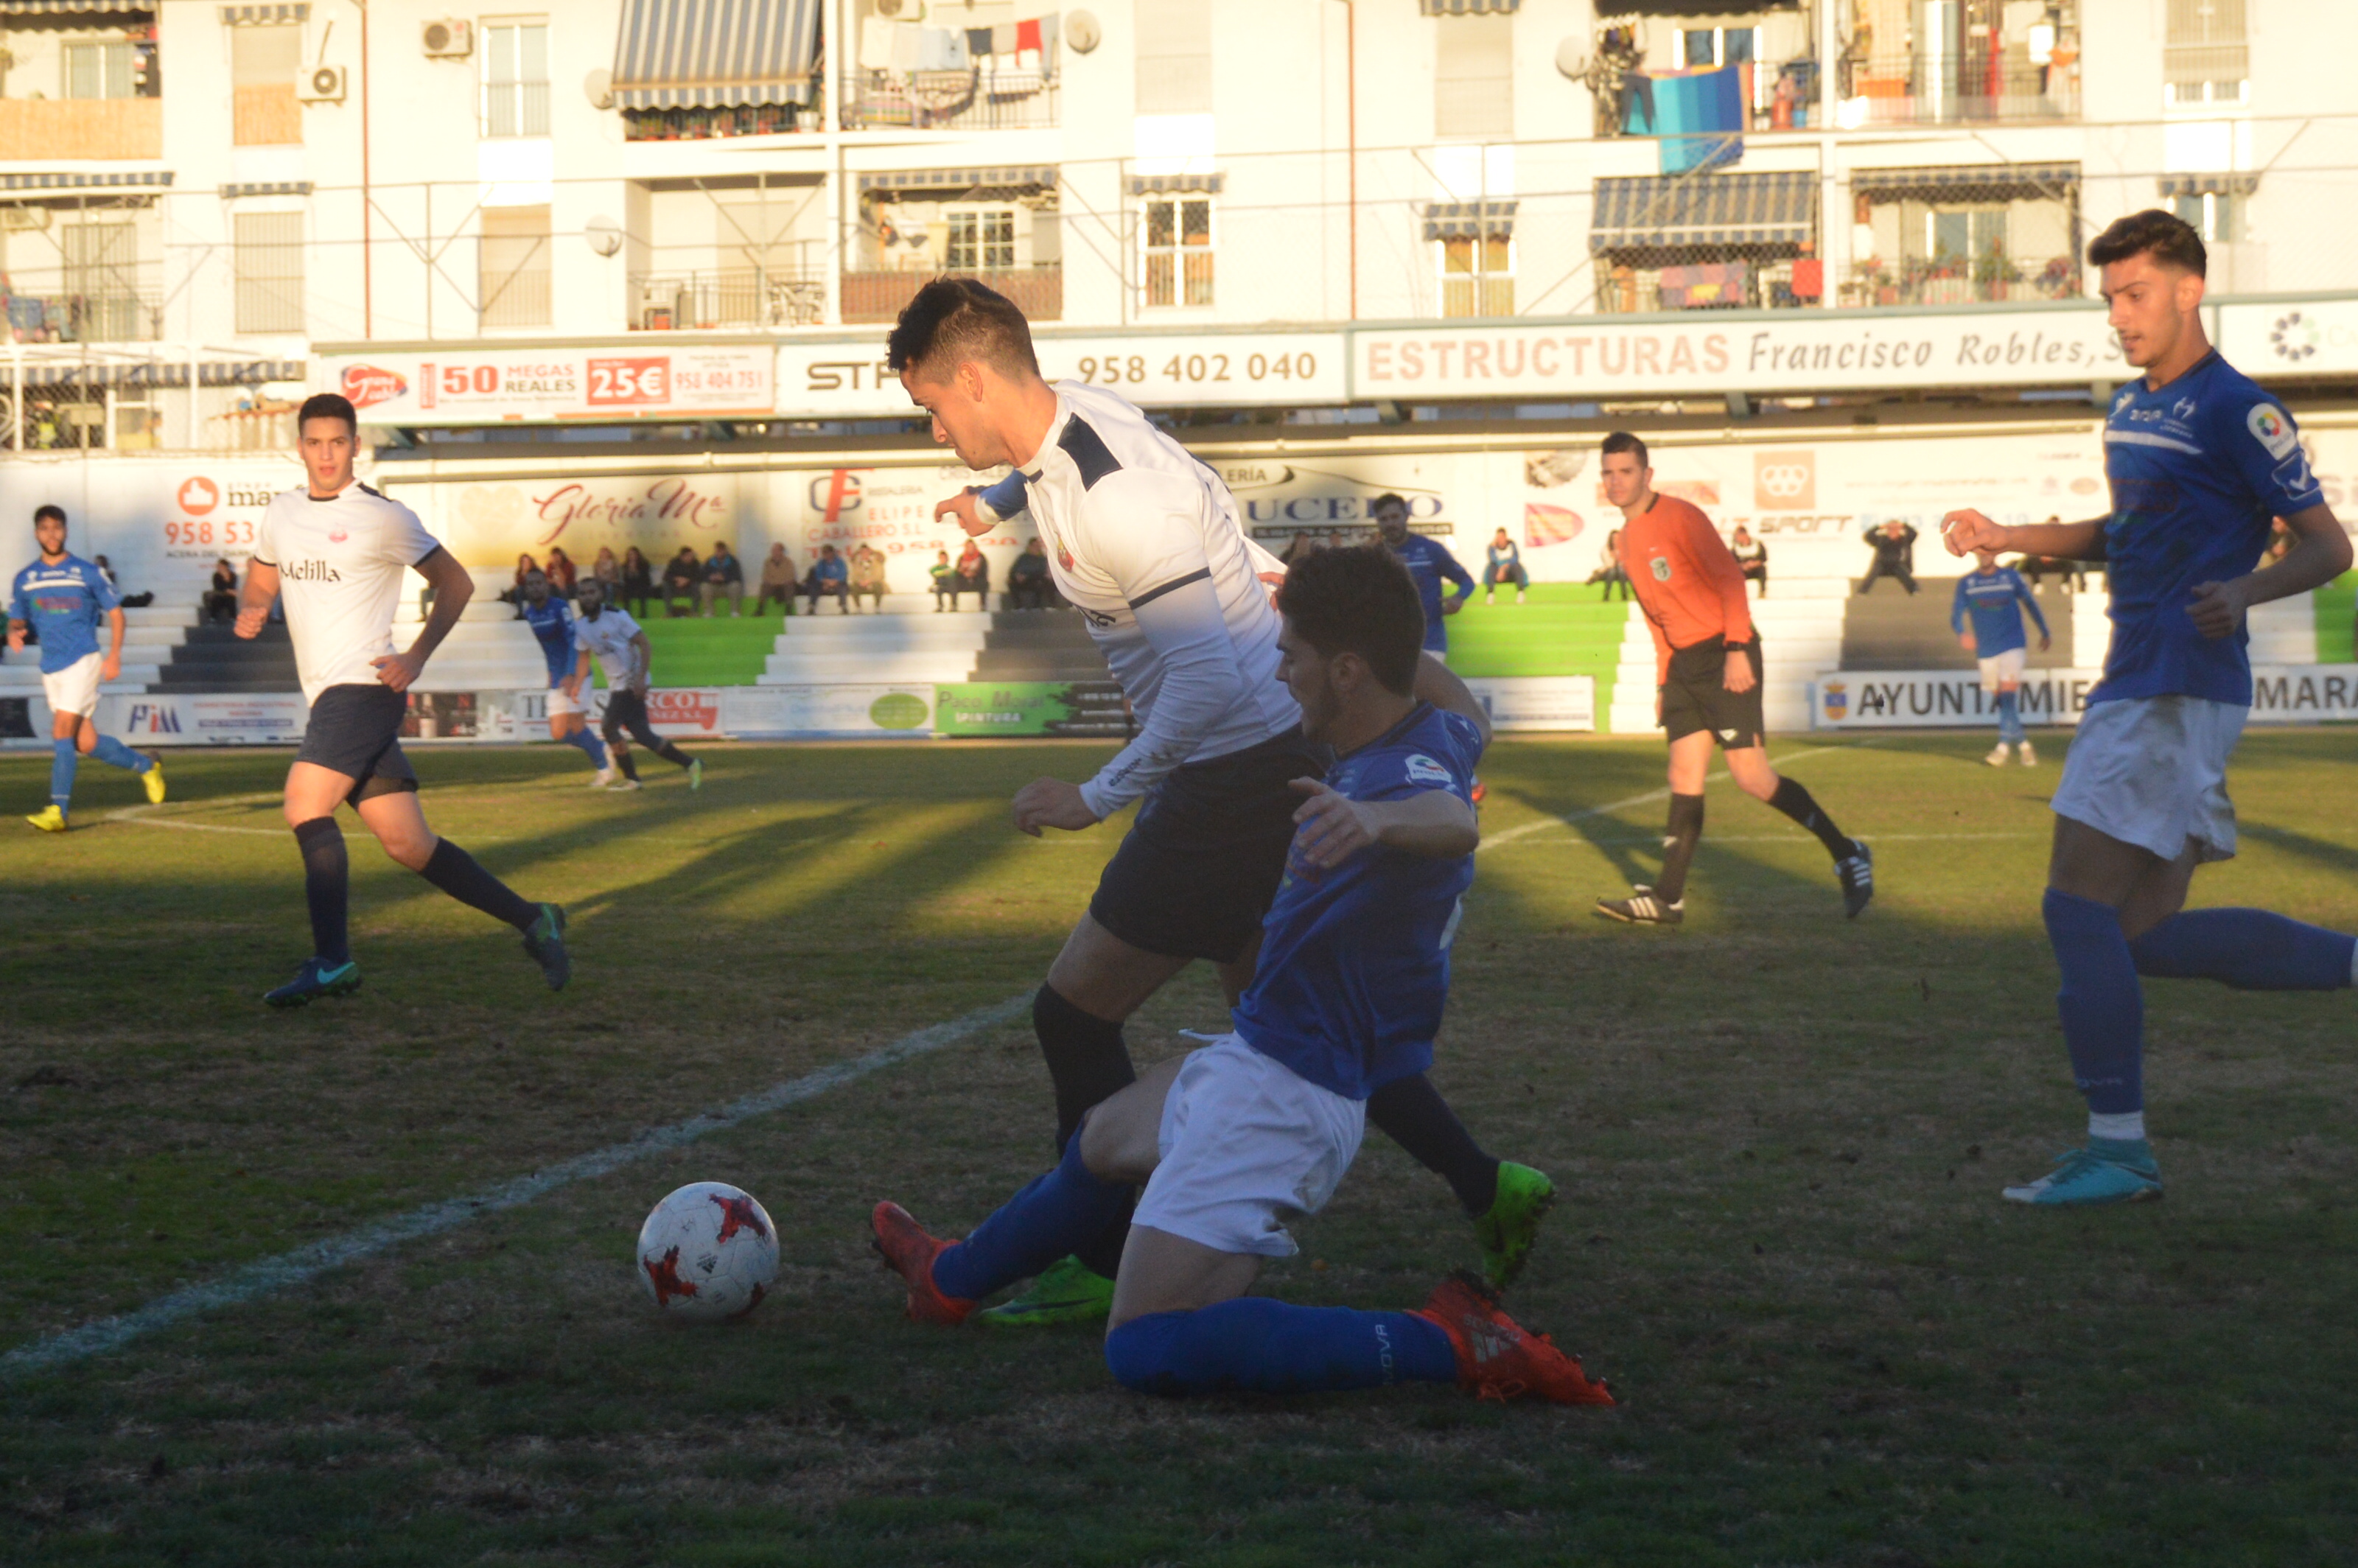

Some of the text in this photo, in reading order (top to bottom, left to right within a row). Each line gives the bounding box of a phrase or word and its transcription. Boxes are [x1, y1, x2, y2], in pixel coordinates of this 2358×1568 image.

[1079, 351, 1316, 385] 958 402 040
[1368, 333, 1730, 381] ESTRUCTURAS
[1749, 330, 1933, 373] Francisco
[444, 365, 499, 394] 50
[507, 364, 574, 378] MEGAS
[592, 366, 663, 399] 25€
[675, 371, 702, 390] 958
[505, 379, 577, 393] REALES
[531, 483, 646, 546] Gloria
[1758, 514, 1854, 534] SPORT
[165, 521, 255, 545] 958 53
[1857, 682, 2090, 715] AYUNTMIE
